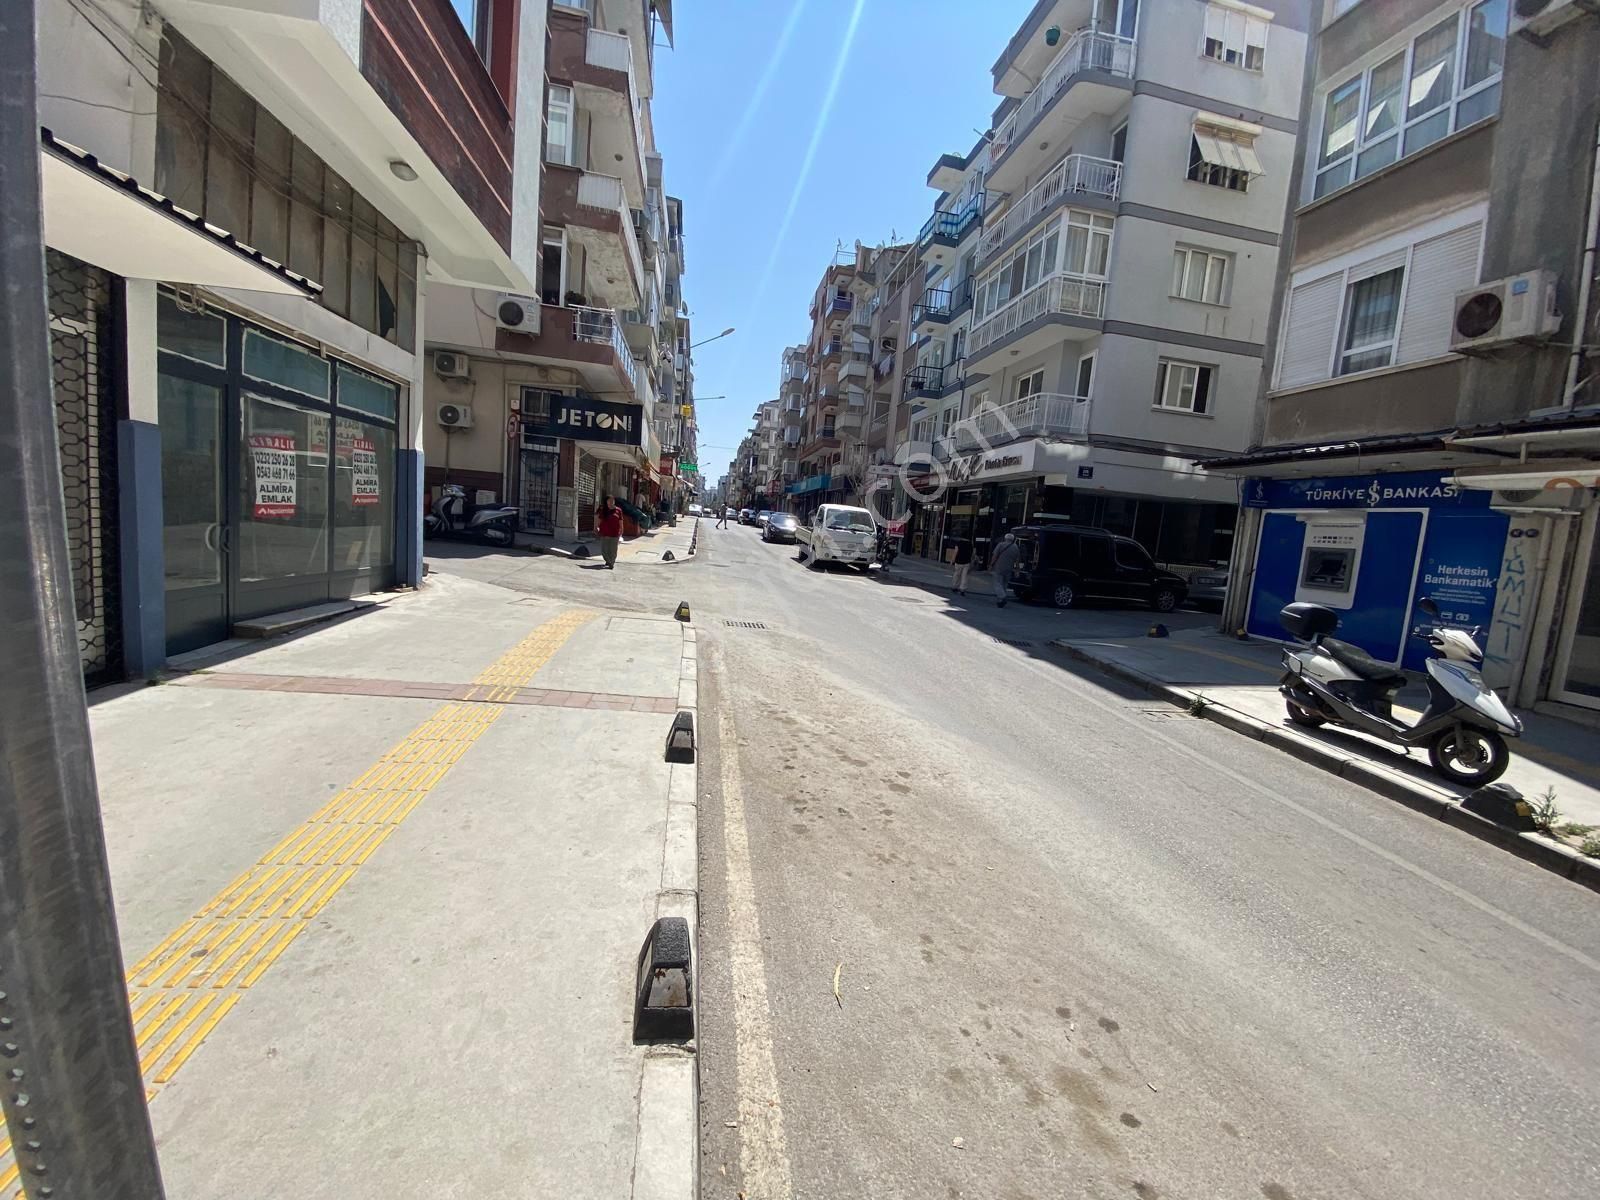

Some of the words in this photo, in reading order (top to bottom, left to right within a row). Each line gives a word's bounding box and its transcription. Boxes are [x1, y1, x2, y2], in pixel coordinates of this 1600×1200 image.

[557, 407, 628, 431] JETON
[249, 436, 296, 450] KIRALIK
[260, 482, 293, 494] ALMİRA
[1306, 488, 1365, 501] TÜRKİYE
[1383, 486, 1459, 499] BANKASI
[261, 495, 292, 503] EMLAK
[1437, 565, 1489, 577] Herkesin
